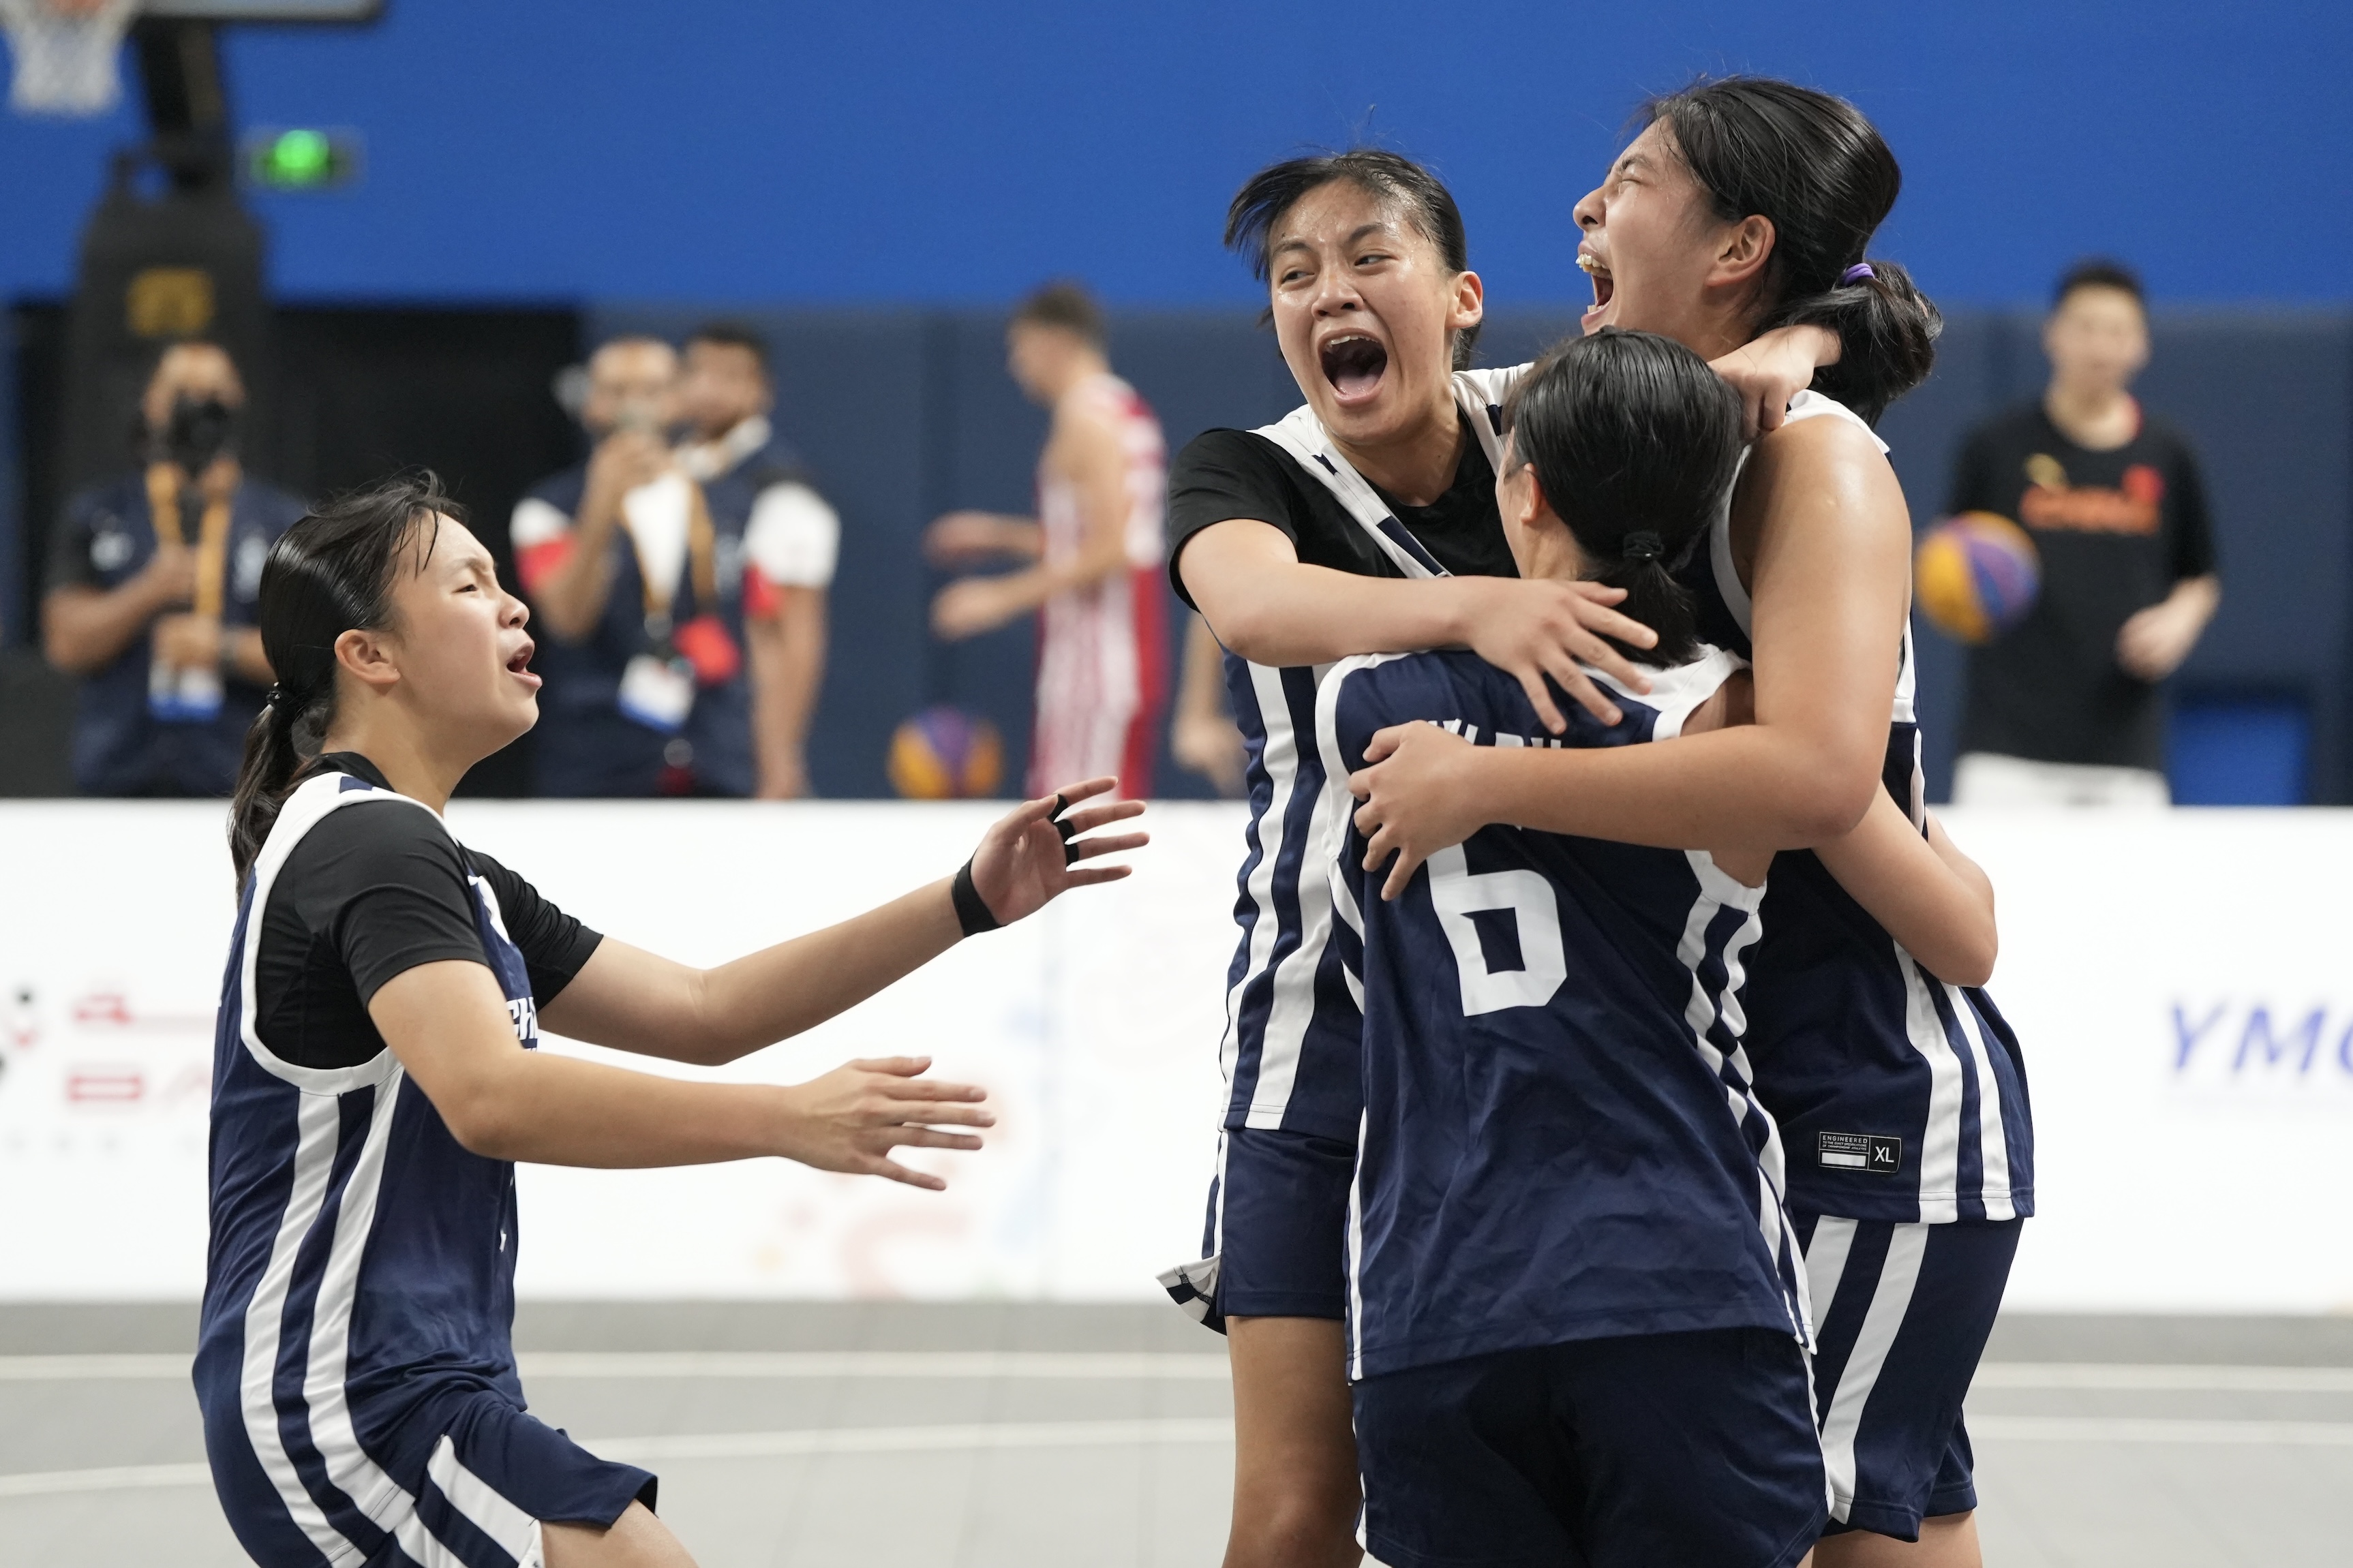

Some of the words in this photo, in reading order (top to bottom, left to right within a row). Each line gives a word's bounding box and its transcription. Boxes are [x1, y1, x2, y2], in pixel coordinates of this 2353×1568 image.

[1426, 825, 1568, 1017] 6
[1822, 1135, 1868, 1144] ENGINEERED
[1874, 1146, 1895, 1163] XL
